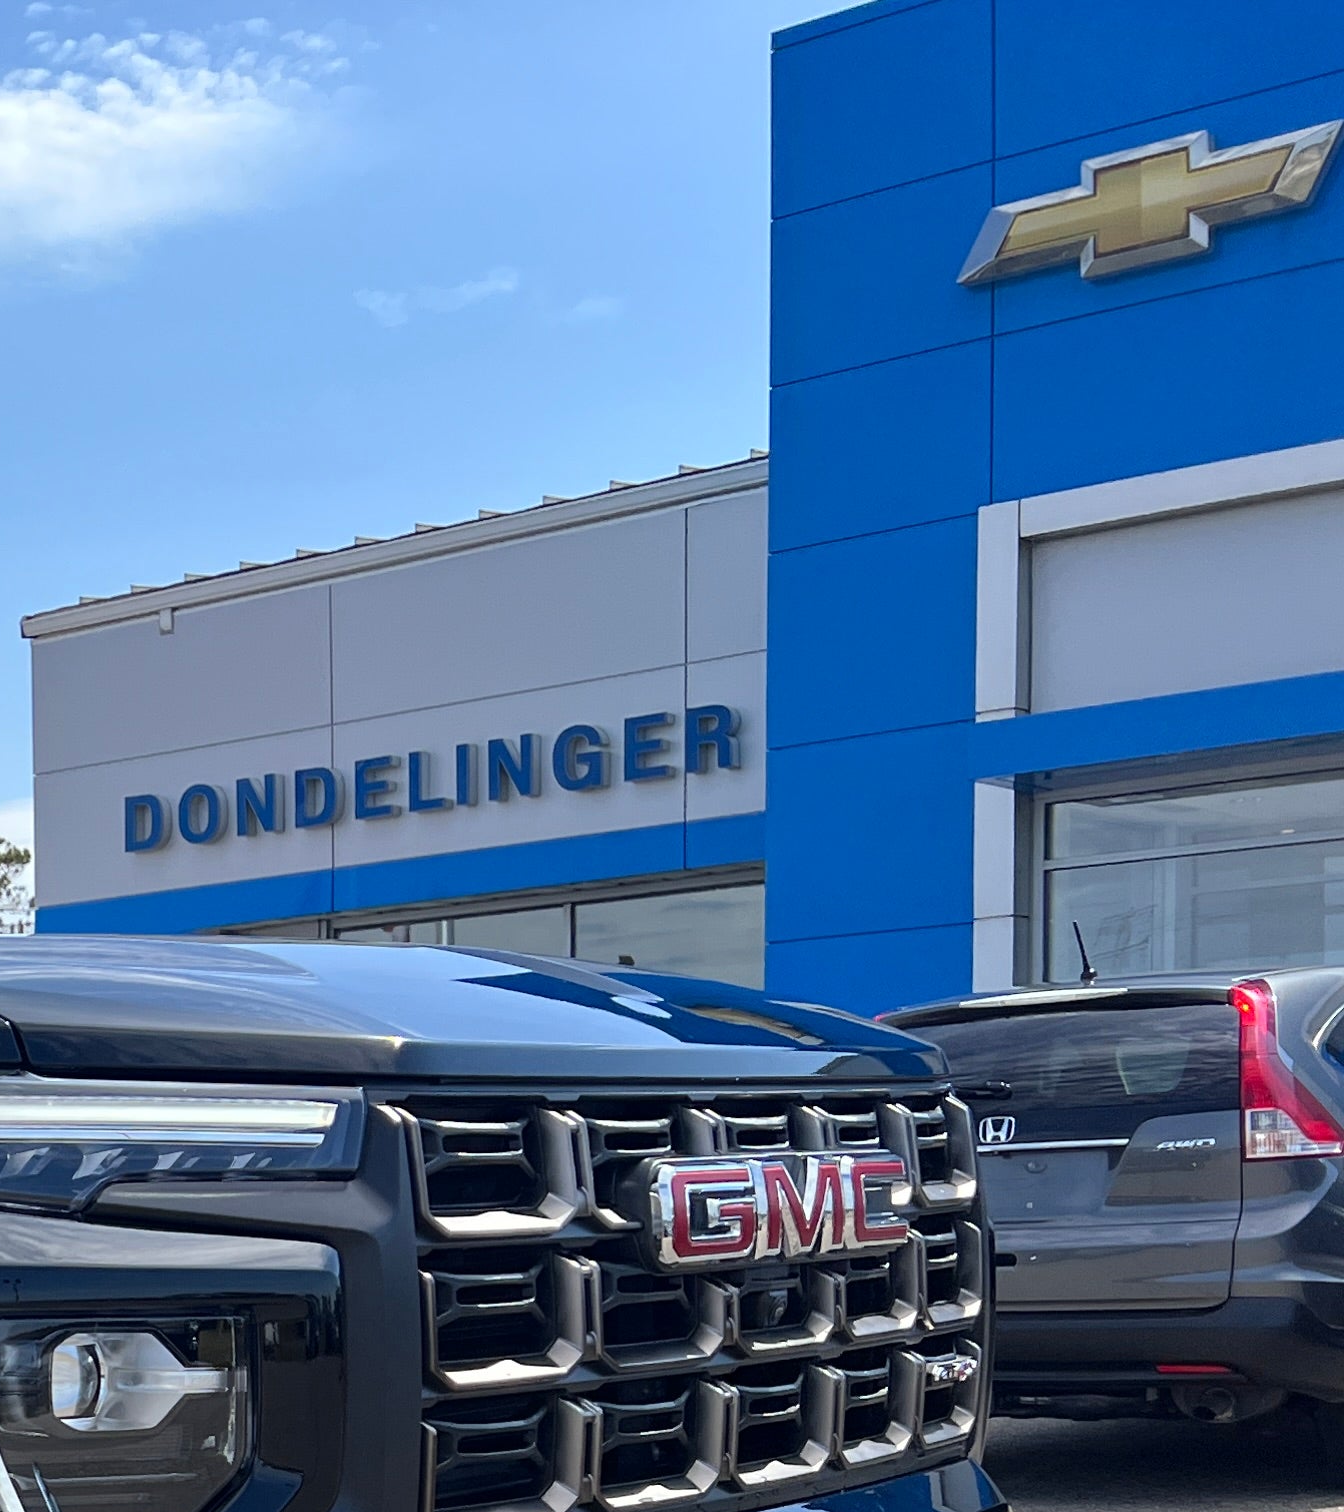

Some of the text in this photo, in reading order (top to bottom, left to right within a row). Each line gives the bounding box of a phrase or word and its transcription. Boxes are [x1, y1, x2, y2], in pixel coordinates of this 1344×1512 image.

[124, 704, 742, 853] DONDELINGER
[1156, 1137, 1216, 1151] AWD
[658, 1155, 910, 1264] GMC
